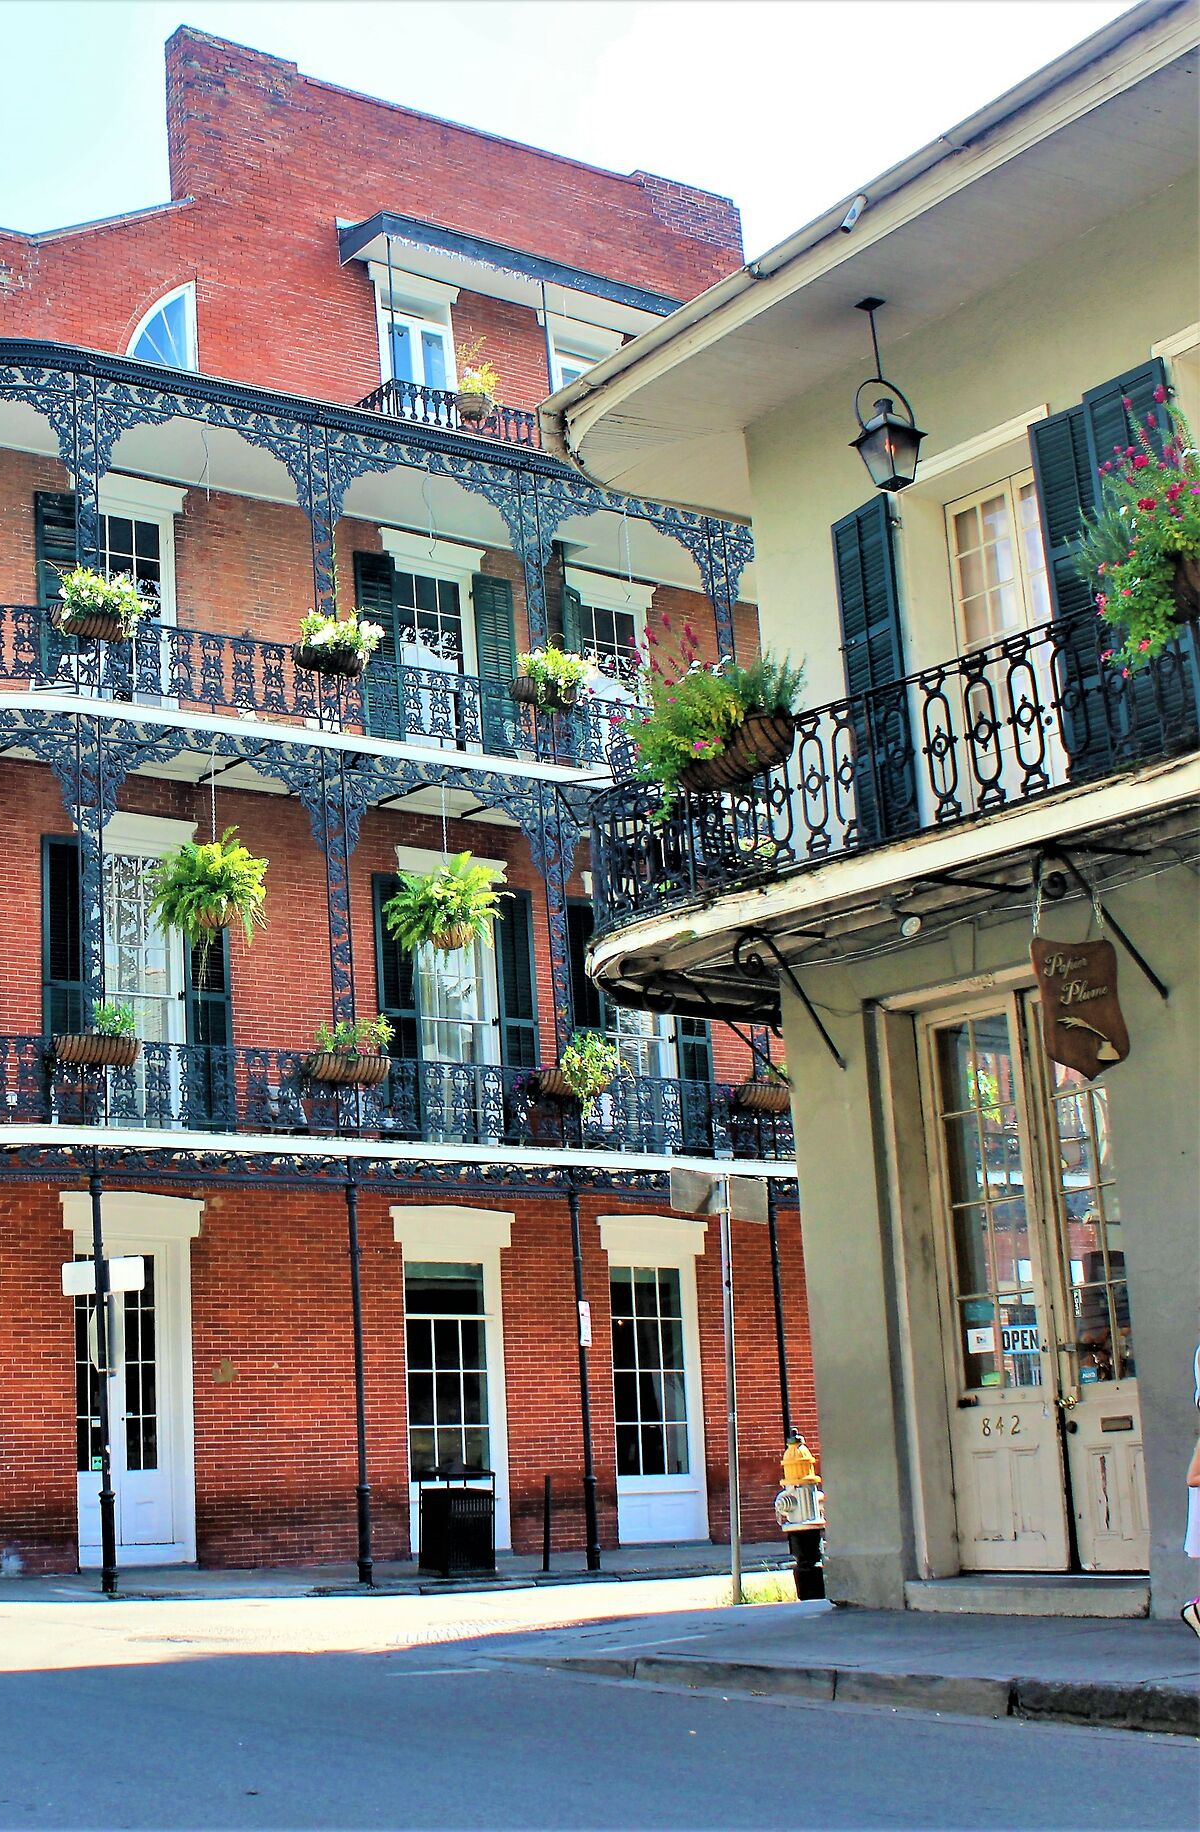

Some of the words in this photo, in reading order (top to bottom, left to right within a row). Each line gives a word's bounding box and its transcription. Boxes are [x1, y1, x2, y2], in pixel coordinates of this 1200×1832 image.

[1060, 980, 1108, 1005] Plume
[1002, 1329, 1039, 1351] OPEN
[982, 1415, 1021, 1437] 842
